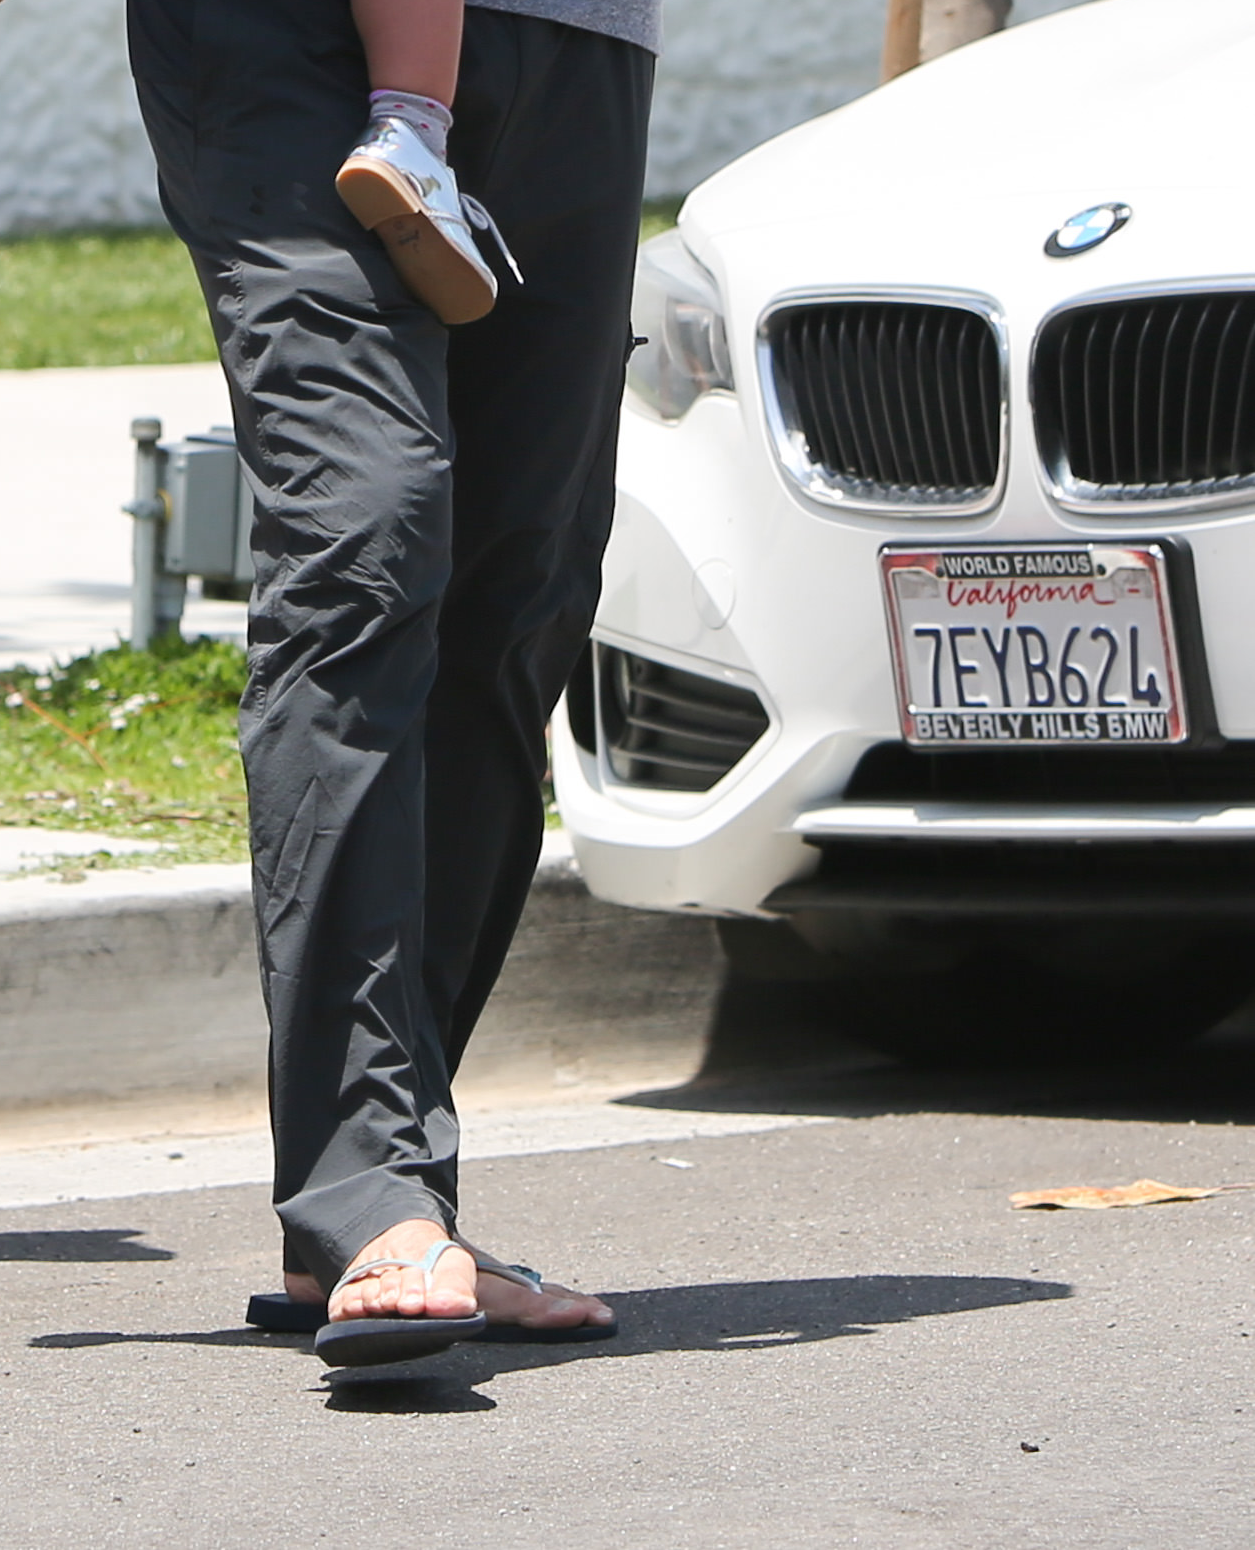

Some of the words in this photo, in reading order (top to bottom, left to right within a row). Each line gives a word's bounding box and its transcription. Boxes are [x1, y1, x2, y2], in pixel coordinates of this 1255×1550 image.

[945, 554, 1010, 576] WORLD
[1015, 554, 1091, 575] FAMOUS
[947, 579, 1116, 618] California
[912, 625, 1161, 707] 7EYB624
[916, 715, 1022, 739] BEVERLY
[1031, 714, 1099, 738] HILLS
